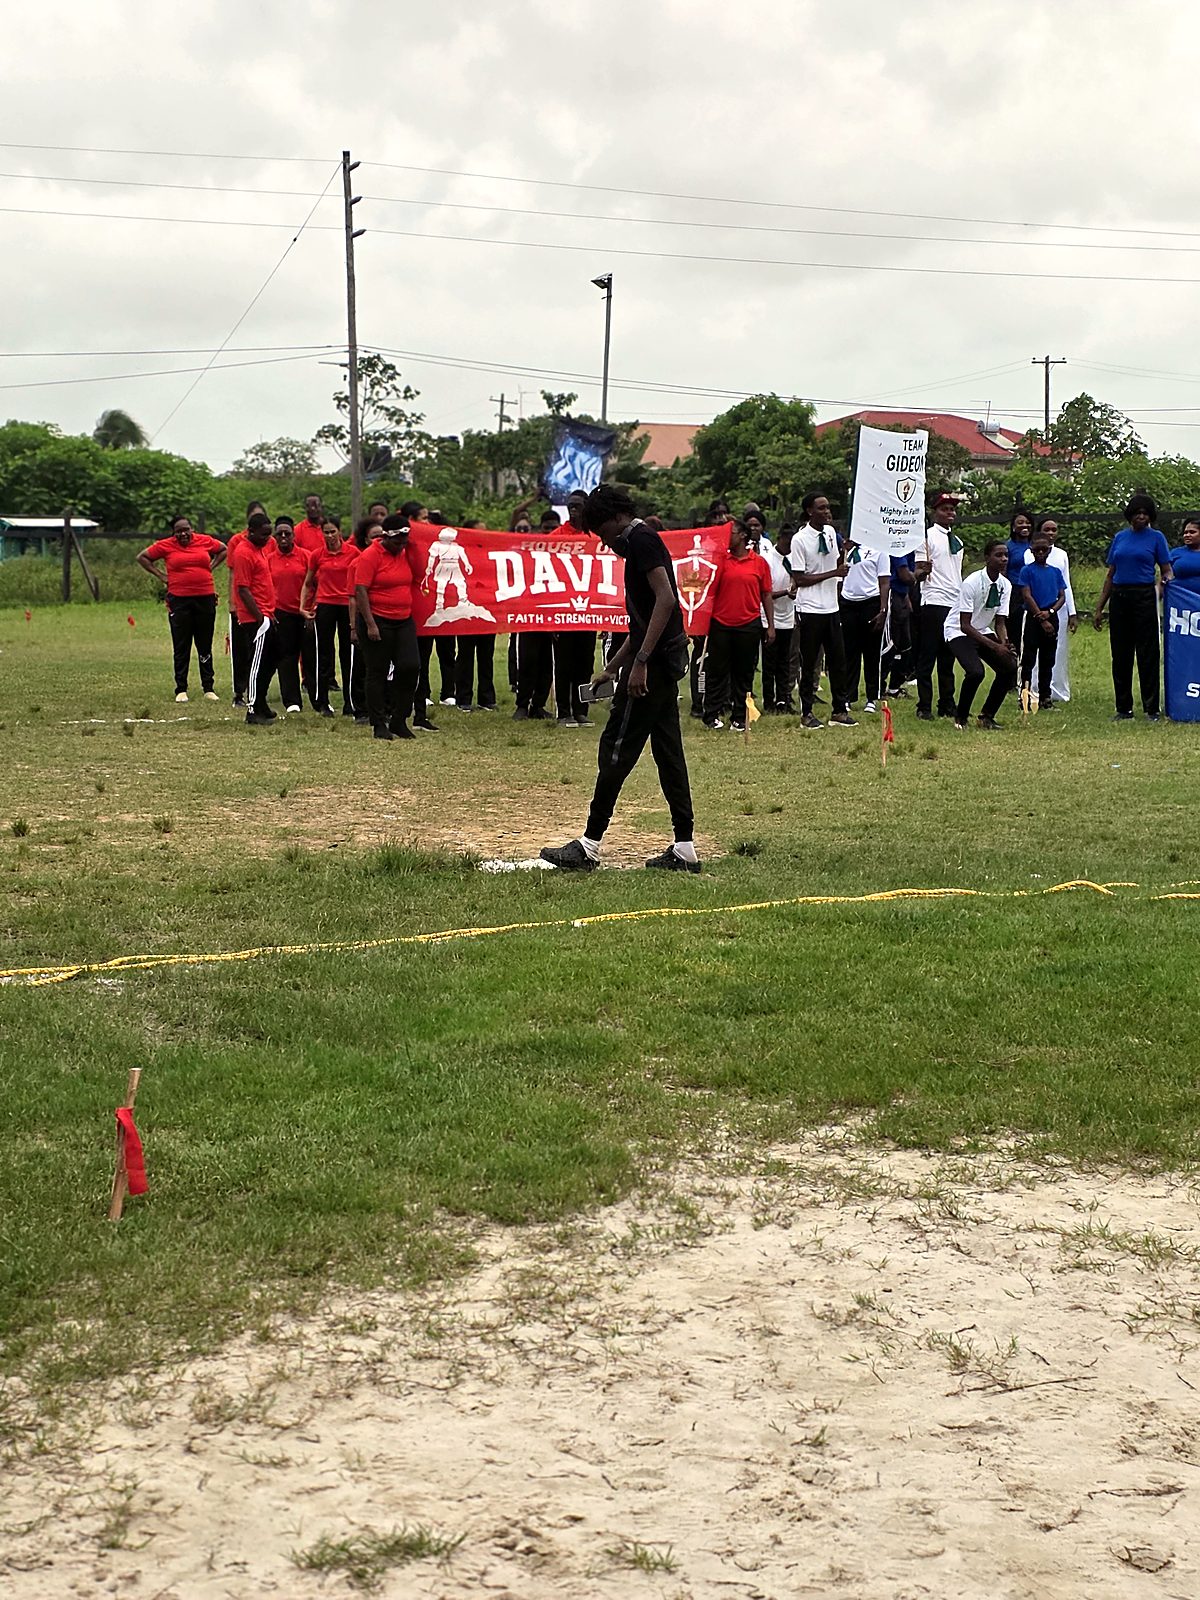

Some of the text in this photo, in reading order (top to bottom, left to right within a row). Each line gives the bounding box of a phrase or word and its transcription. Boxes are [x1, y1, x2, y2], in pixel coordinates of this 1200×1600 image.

[903, 439, 924, 451] TEAM
[880, 506, 902, 516] Mighty
[888, 527, 910, 536] Purpose
[520, 541, 586, 554] HOUSE
[488, 551, 627, 602] DAVI
[507, 613, 544, 624] FAITH
[554, 613, 603, 625] STRENGTH
[1186, 682, 1200, 698] S
